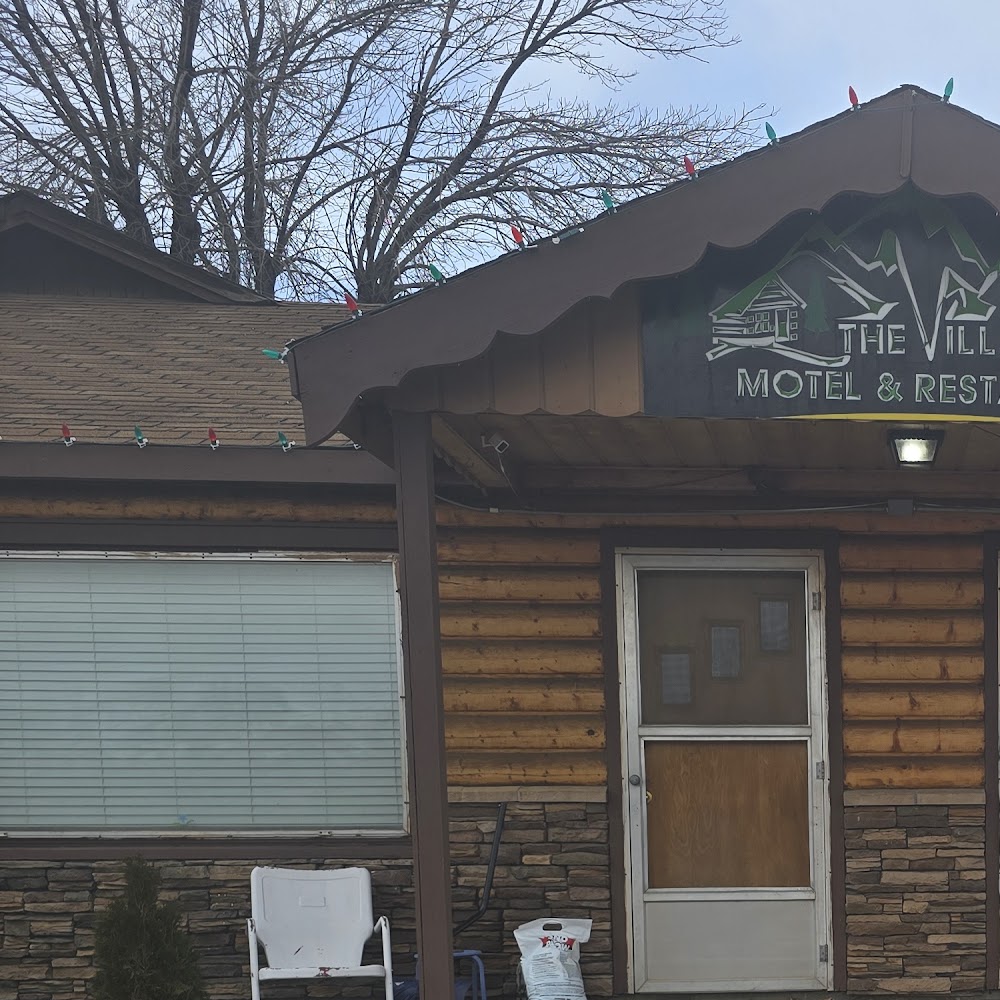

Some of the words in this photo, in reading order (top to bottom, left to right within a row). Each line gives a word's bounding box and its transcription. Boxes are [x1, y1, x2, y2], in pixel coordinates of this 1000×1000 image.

[838, 324, 905, 354] THE
[738, 368, 861, 401] MOTEL
[877, 372, 904, 402] &
